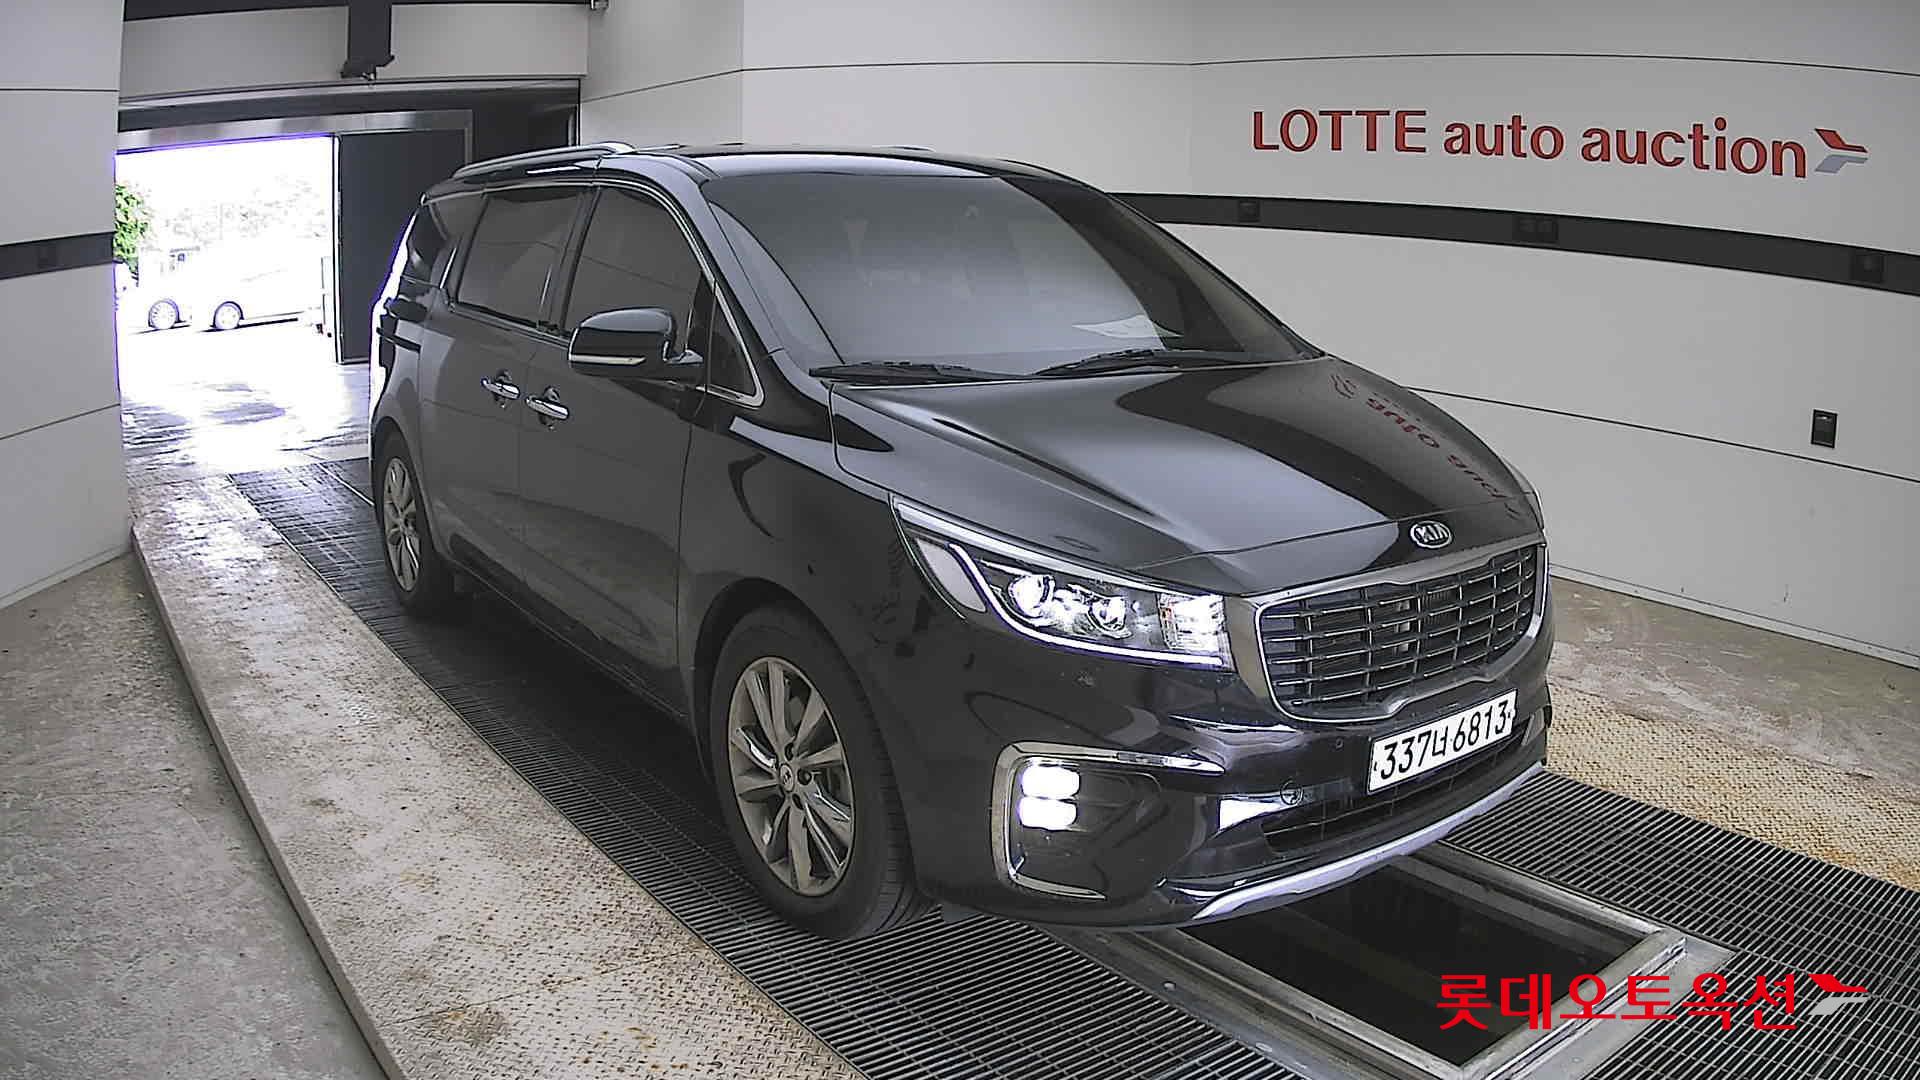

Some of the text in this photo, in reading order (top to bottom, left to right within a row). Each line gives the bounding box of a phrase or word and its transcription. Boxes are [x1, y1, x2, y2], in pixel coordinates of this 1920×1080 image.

[1252, 109, 1808, 179] LOTTE auto auction
[1414, 522, 1449, 544] KIA
